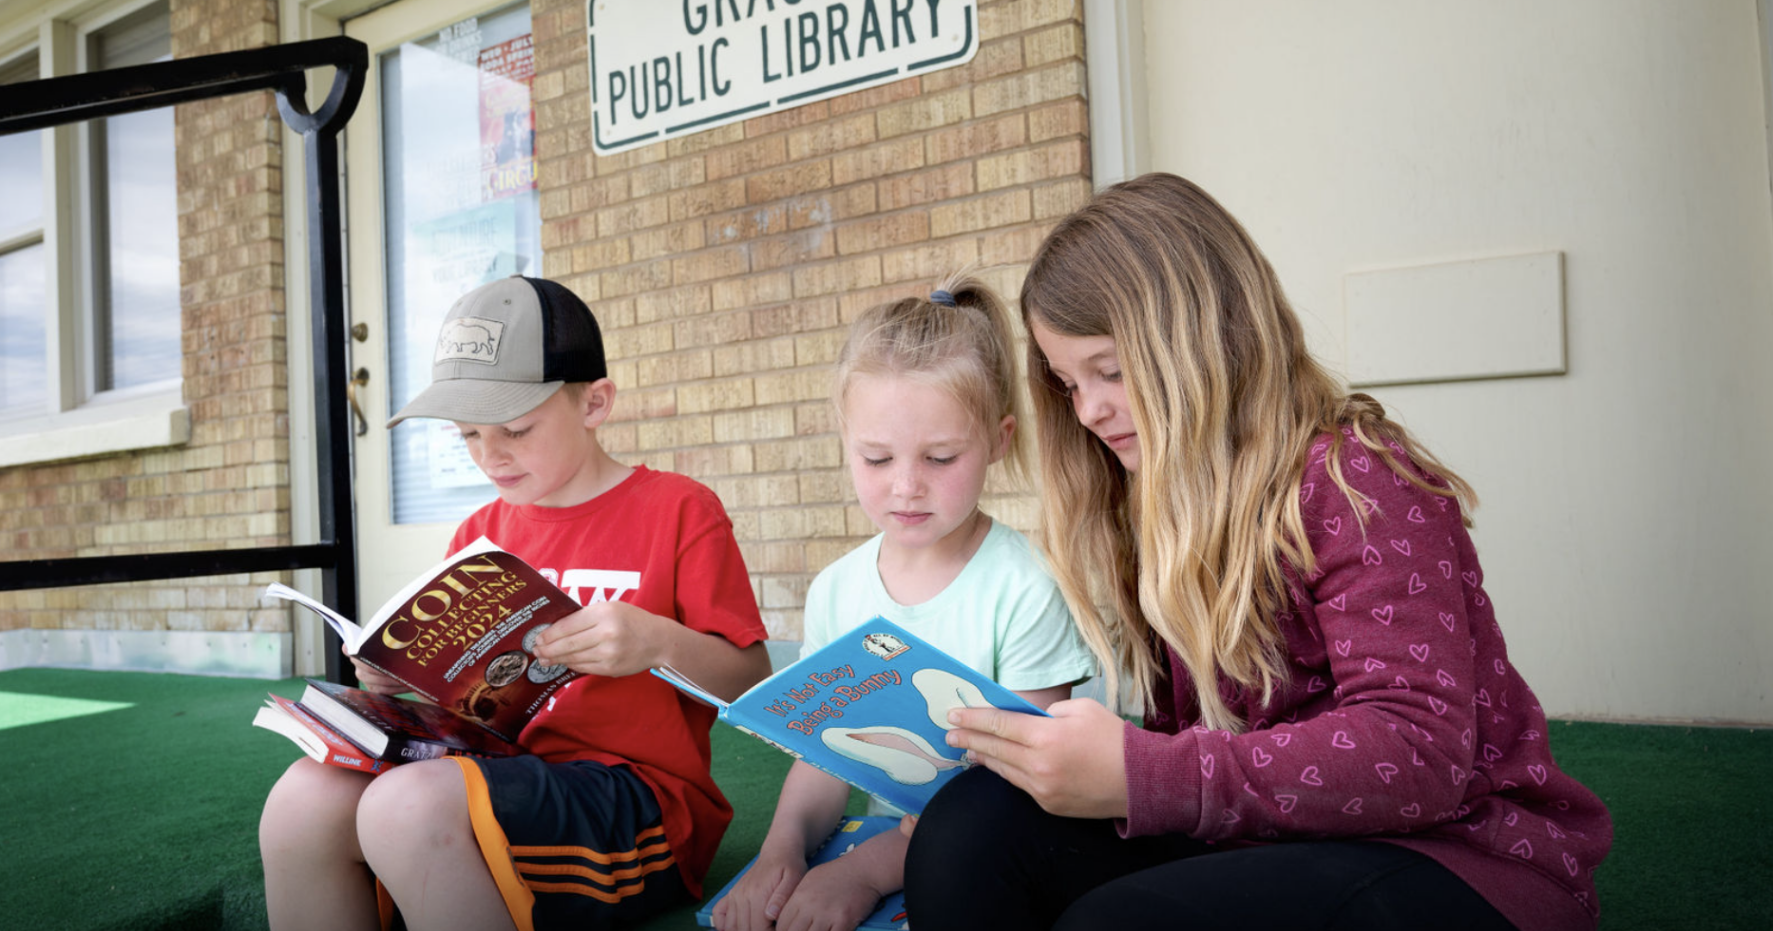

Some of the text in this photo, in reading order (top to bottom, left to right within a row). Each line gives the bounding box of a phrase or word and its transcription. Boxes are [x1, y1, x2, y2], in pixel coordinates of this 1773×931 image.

[608, 0, 943, 125] PUBLIC LIBRARY
[382, 554, 505, 650] COIN
[406, 571, 518, 660] COLLECTING
[417, 579, 528, 667] FOR BEGINNERS
[452, 604, 513, 652] 2024
[525, 680, 557, 715] THOMAS
[763, 664, 856, 717] It's Not Easy
[786, 669, 902, 736] Being a Bunny
